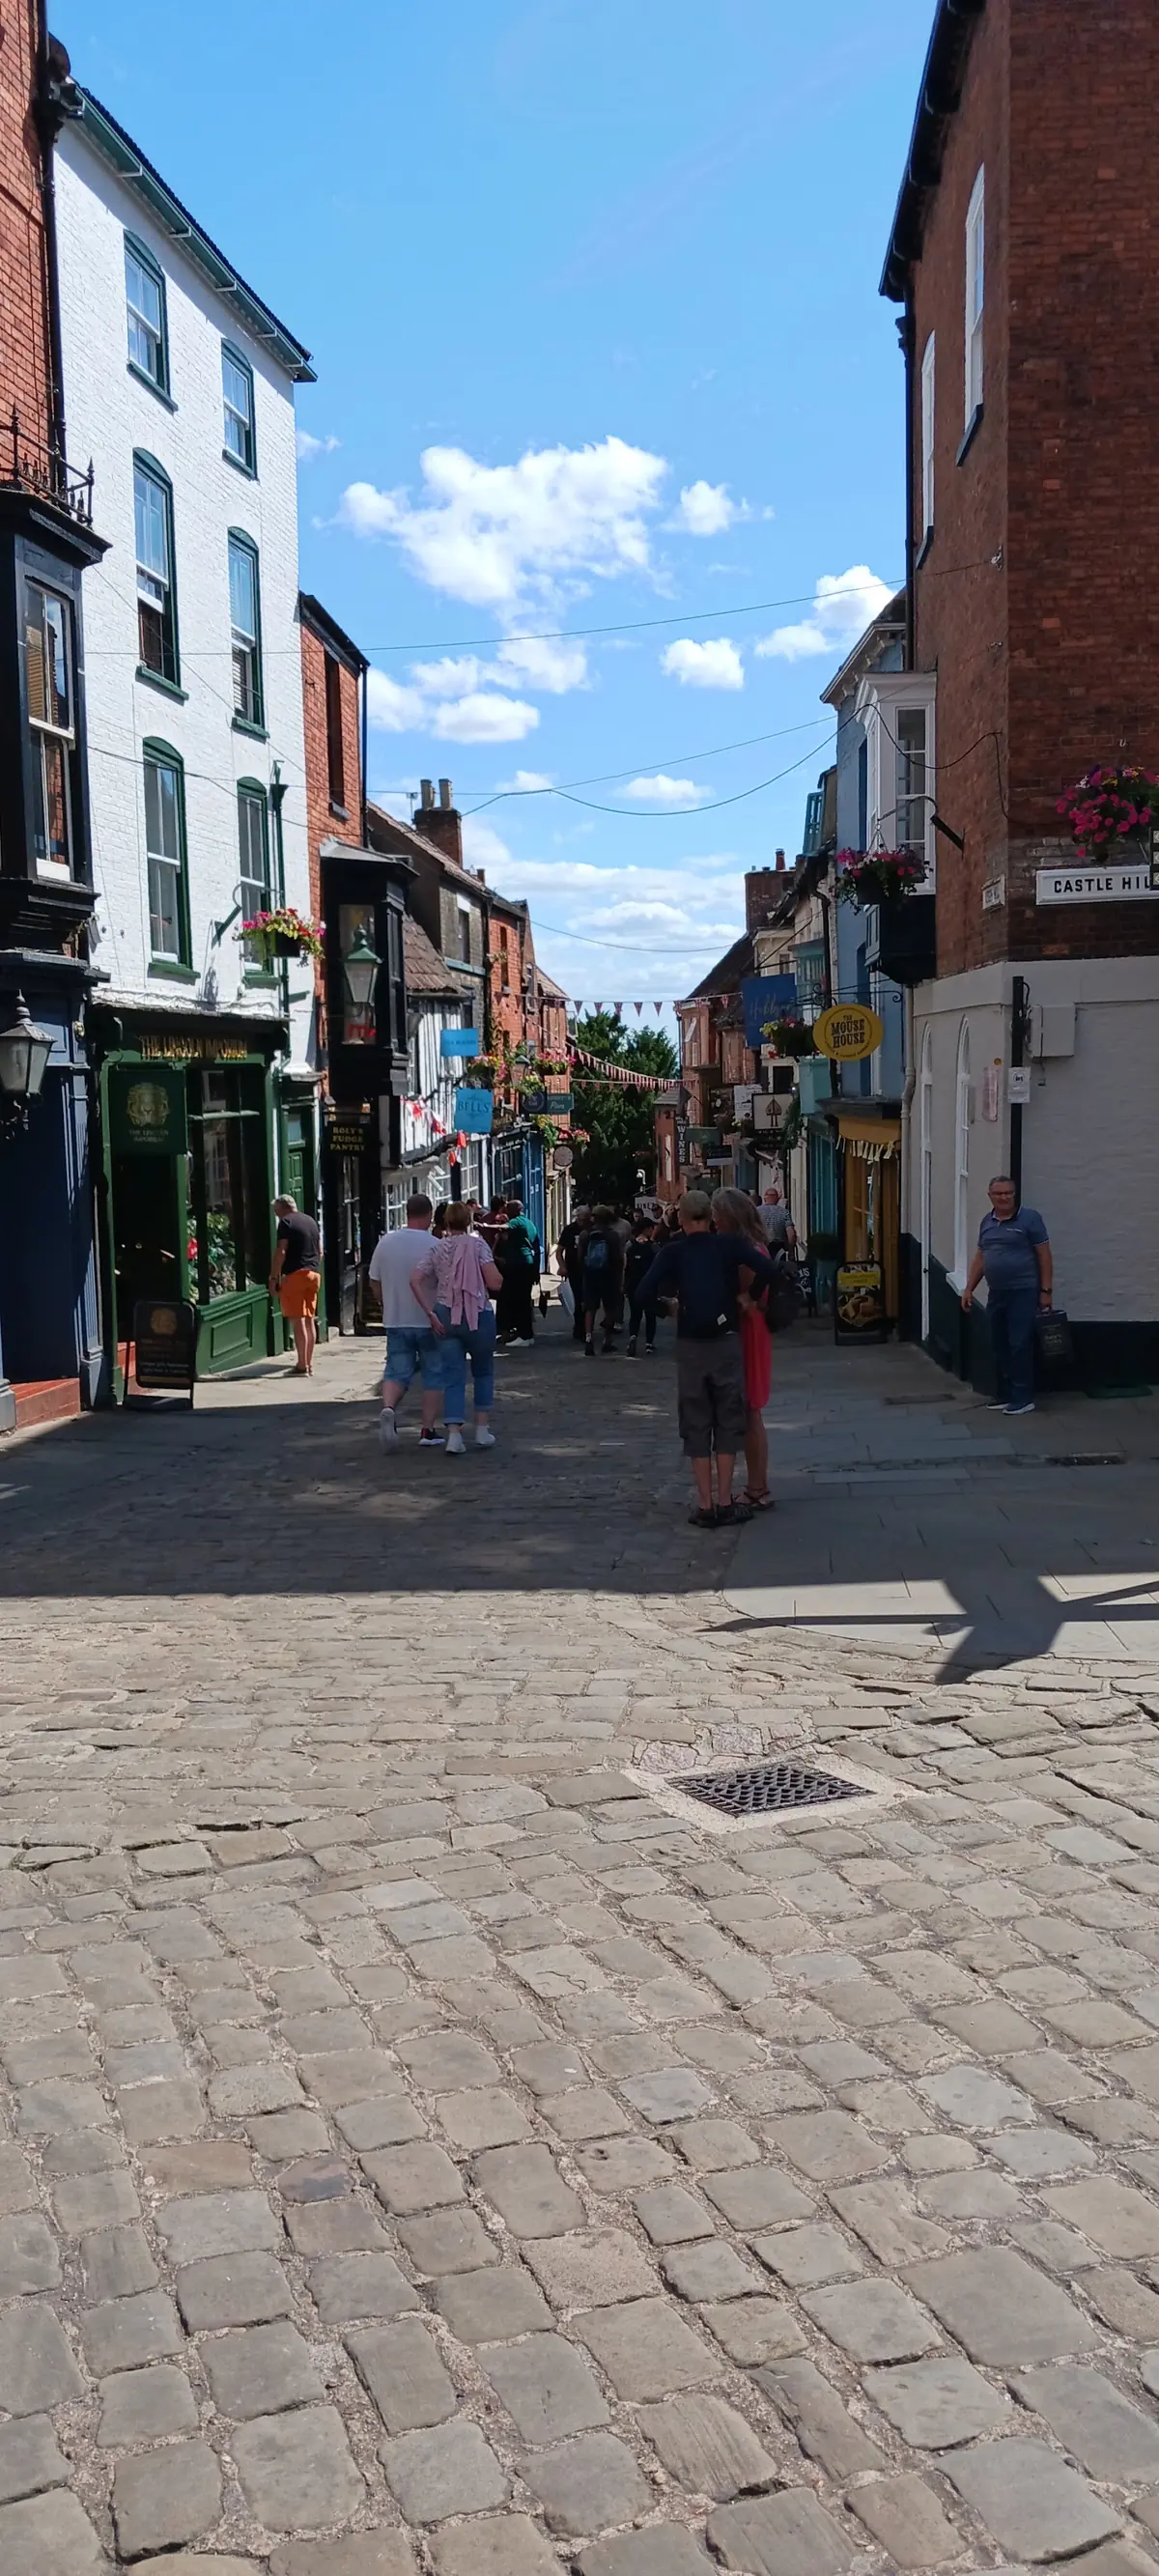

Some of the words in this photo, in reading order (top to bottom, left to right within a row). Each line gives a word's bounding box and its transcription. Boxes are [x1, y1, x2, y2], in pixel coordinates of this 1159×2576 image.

[1054, 877, 1114, 893] CASTLE
[1121, 875, 1150, 891] HIL
[831, 1019, 865, 1036] MOUSE
[833, 1032, 865, 1049] HOUSE
[458, 1100, 490, 1114] BELLS
[332, 1135, 364, 1144] FUDGE
[677, 1125, 686, 1163] WINES
